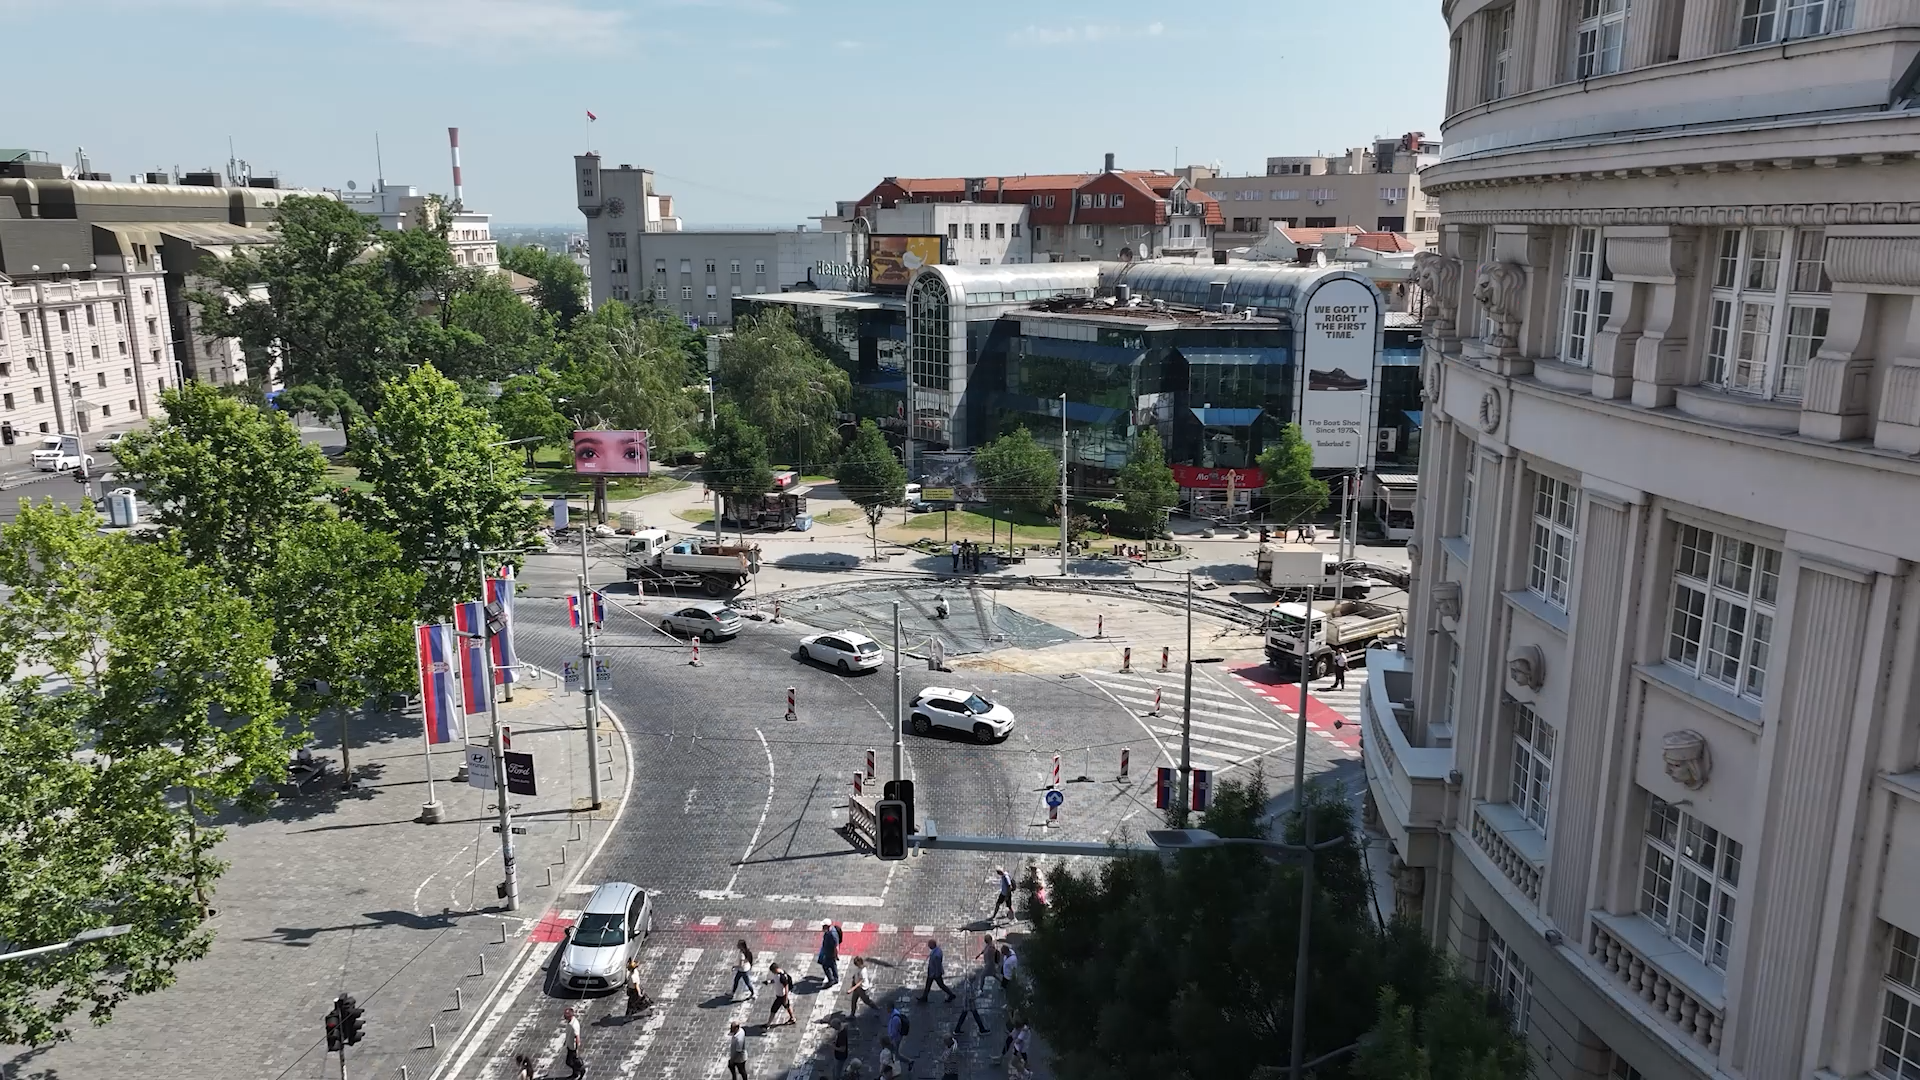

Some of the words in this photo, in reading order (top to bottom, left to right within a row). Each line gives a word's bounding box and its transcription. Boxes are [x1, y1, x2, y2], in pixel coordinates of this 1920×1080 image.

[816, 259, 870, 278] Heineken
[1314, 305, 1331, 314] WE
[1333, 305, 1357, 314] GOT
[1358, 305, 1369, 314] IT
[1325, 314, 1358, 322] RIGHT
[1315, 322, 1335, 330] THE
[1337, 322, 1367, 330] FIRST
[1325, 331, 1355, 339] TIME.
[507, 763, 531, 776] Ford
